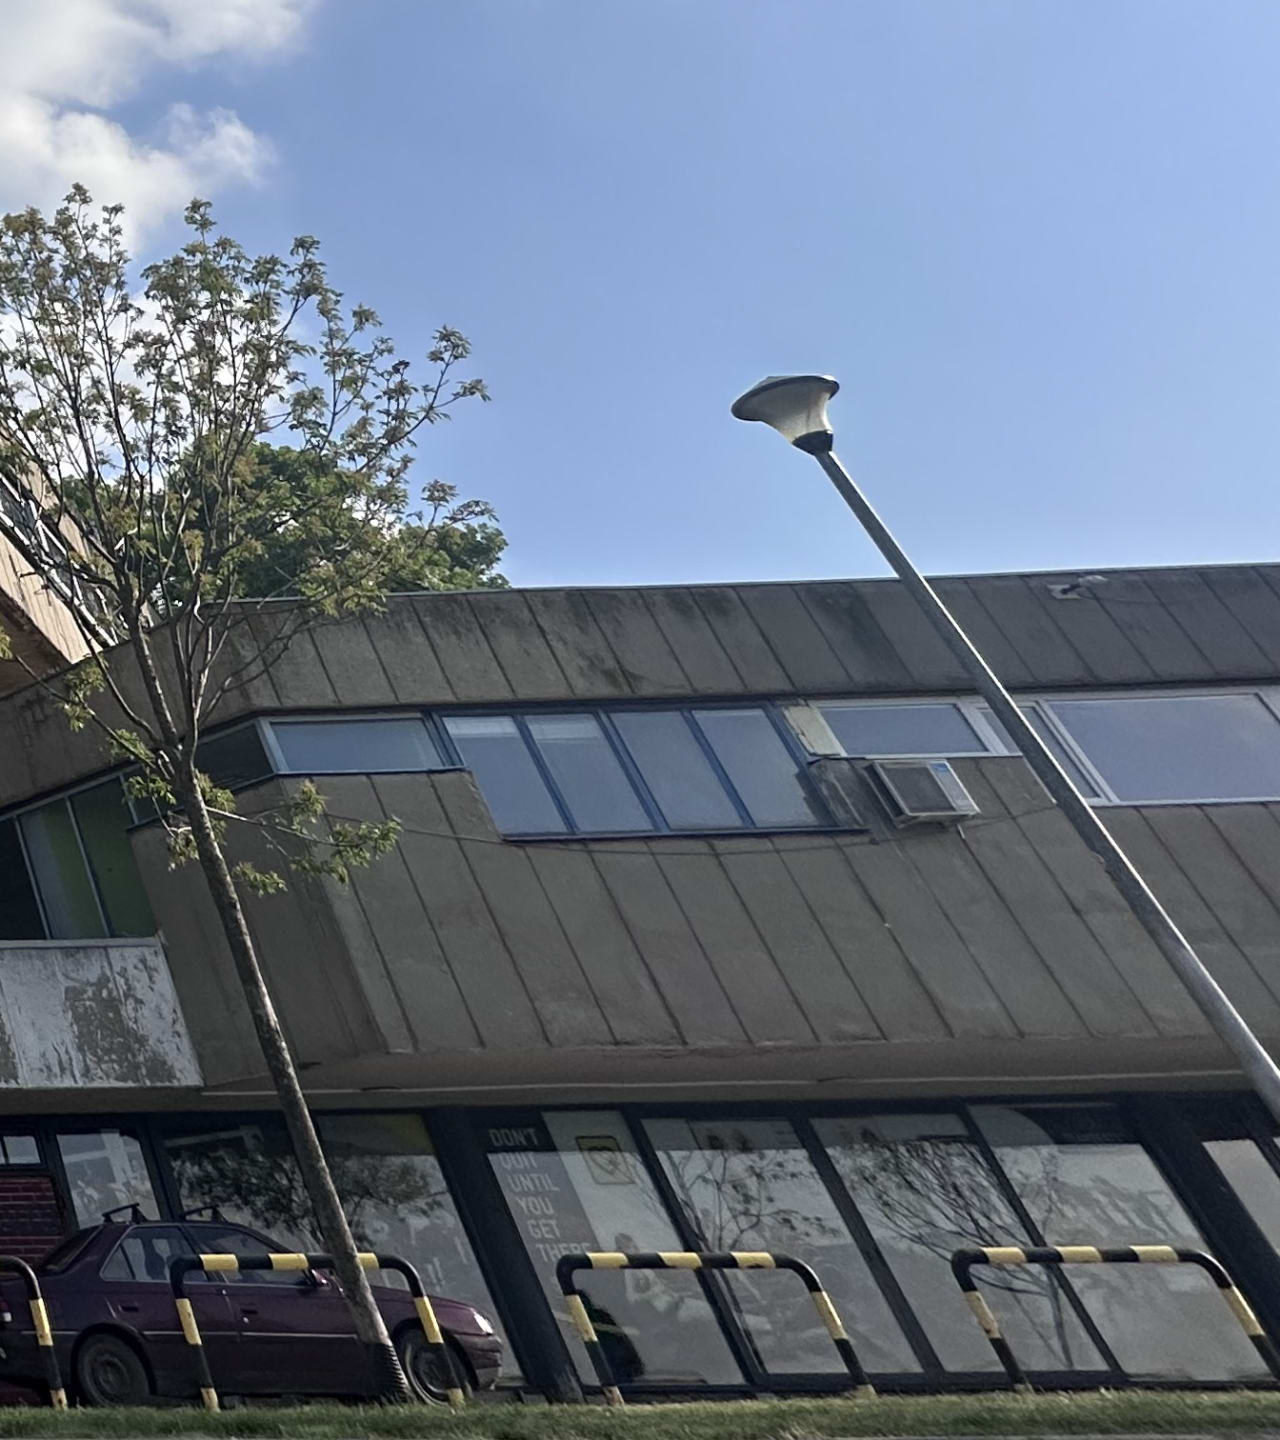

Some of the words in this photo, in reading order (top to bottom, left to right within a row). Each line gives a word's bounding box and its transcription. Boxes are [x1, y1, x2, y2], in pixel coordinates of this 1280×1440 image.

[489, 1128, 539, 1147] DON'T
[500, 1151, 538, 1170] QUIT
[507, 1172, 560, 1192] UNTIL
[516, 1196, 554, 1215] YOU
[528, 1219, 560, 1239] GET
